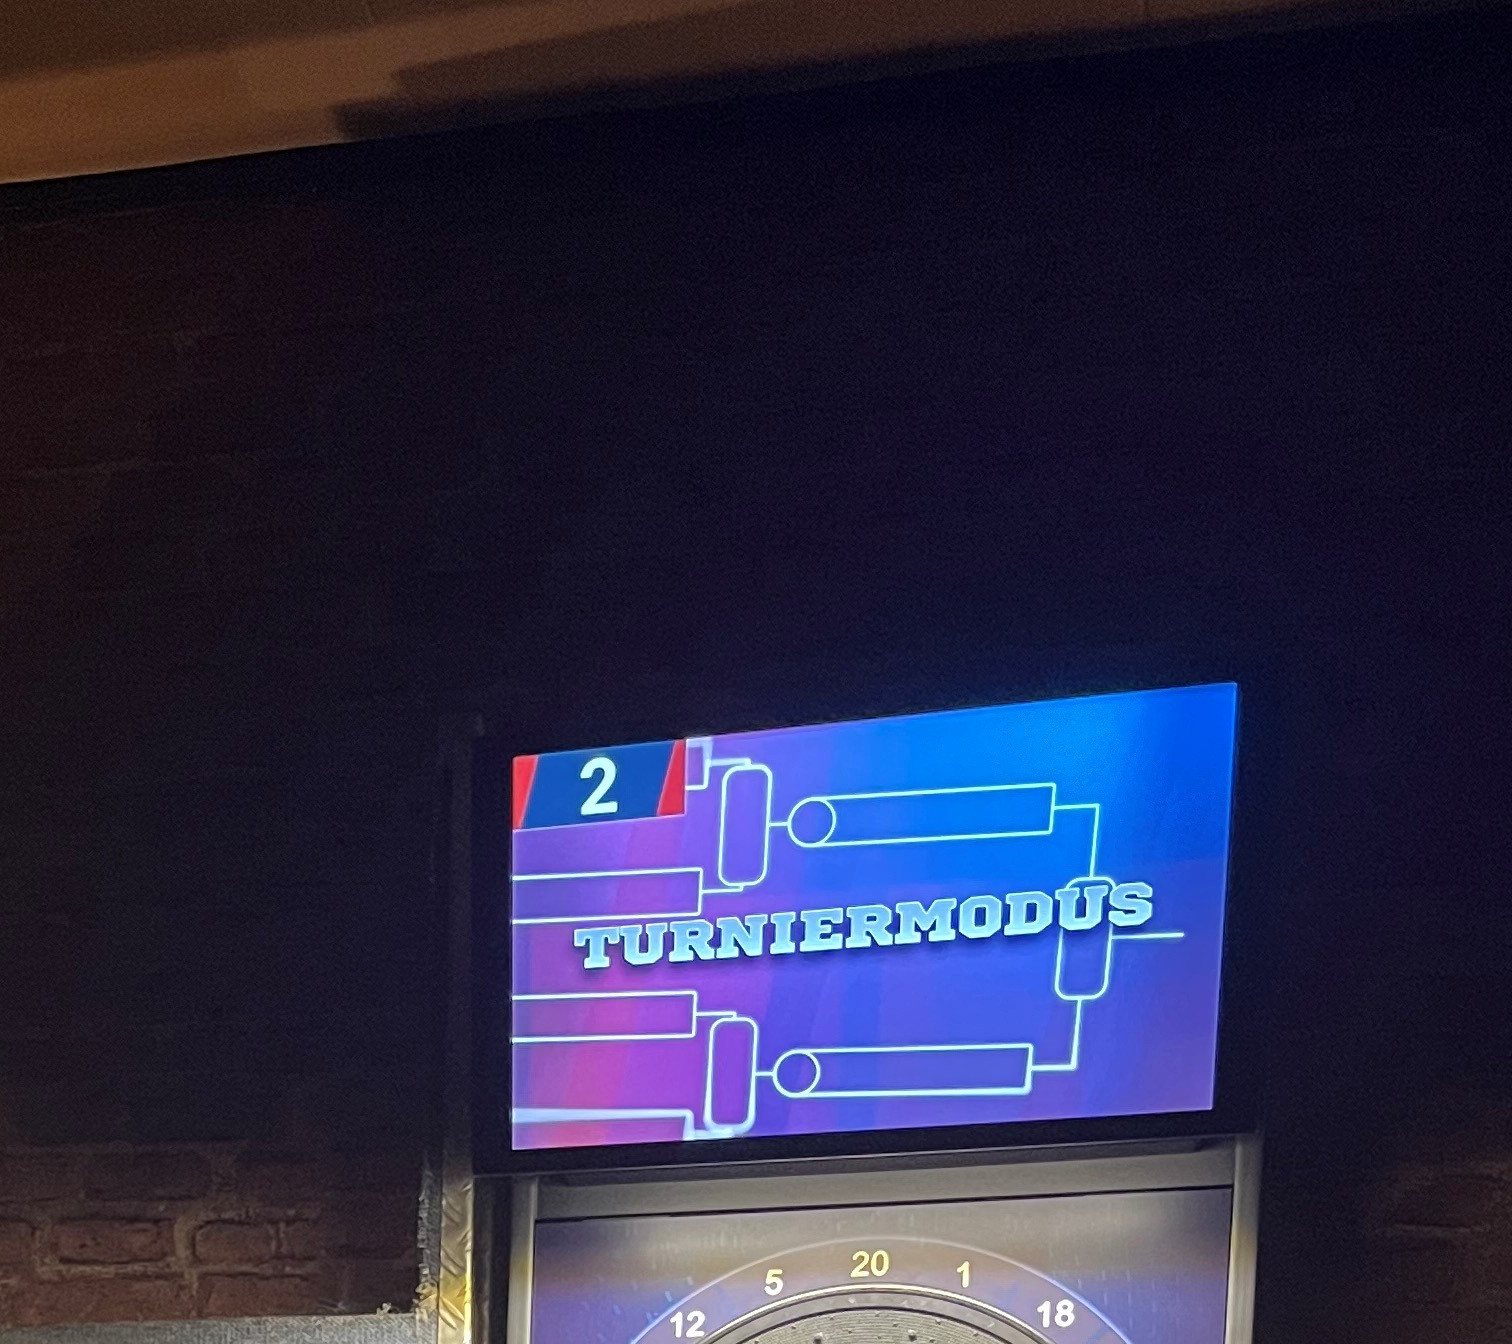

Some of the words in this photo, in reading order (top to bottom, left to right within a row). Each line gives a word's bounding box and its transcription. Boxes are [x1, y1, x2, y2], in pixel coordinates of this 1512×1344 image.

[578, 757, 620, 816] 2
[573, 880, 1155, 970] TURNIERMODUS
[850, 1250, 889, 1278] 20
[956, 1261, 970, 1288] 1
[764, 1269, 784, 1296] 5
[669, 1310, 706, 1338] 12
[1036, 1299, 1076, 1328] 18
